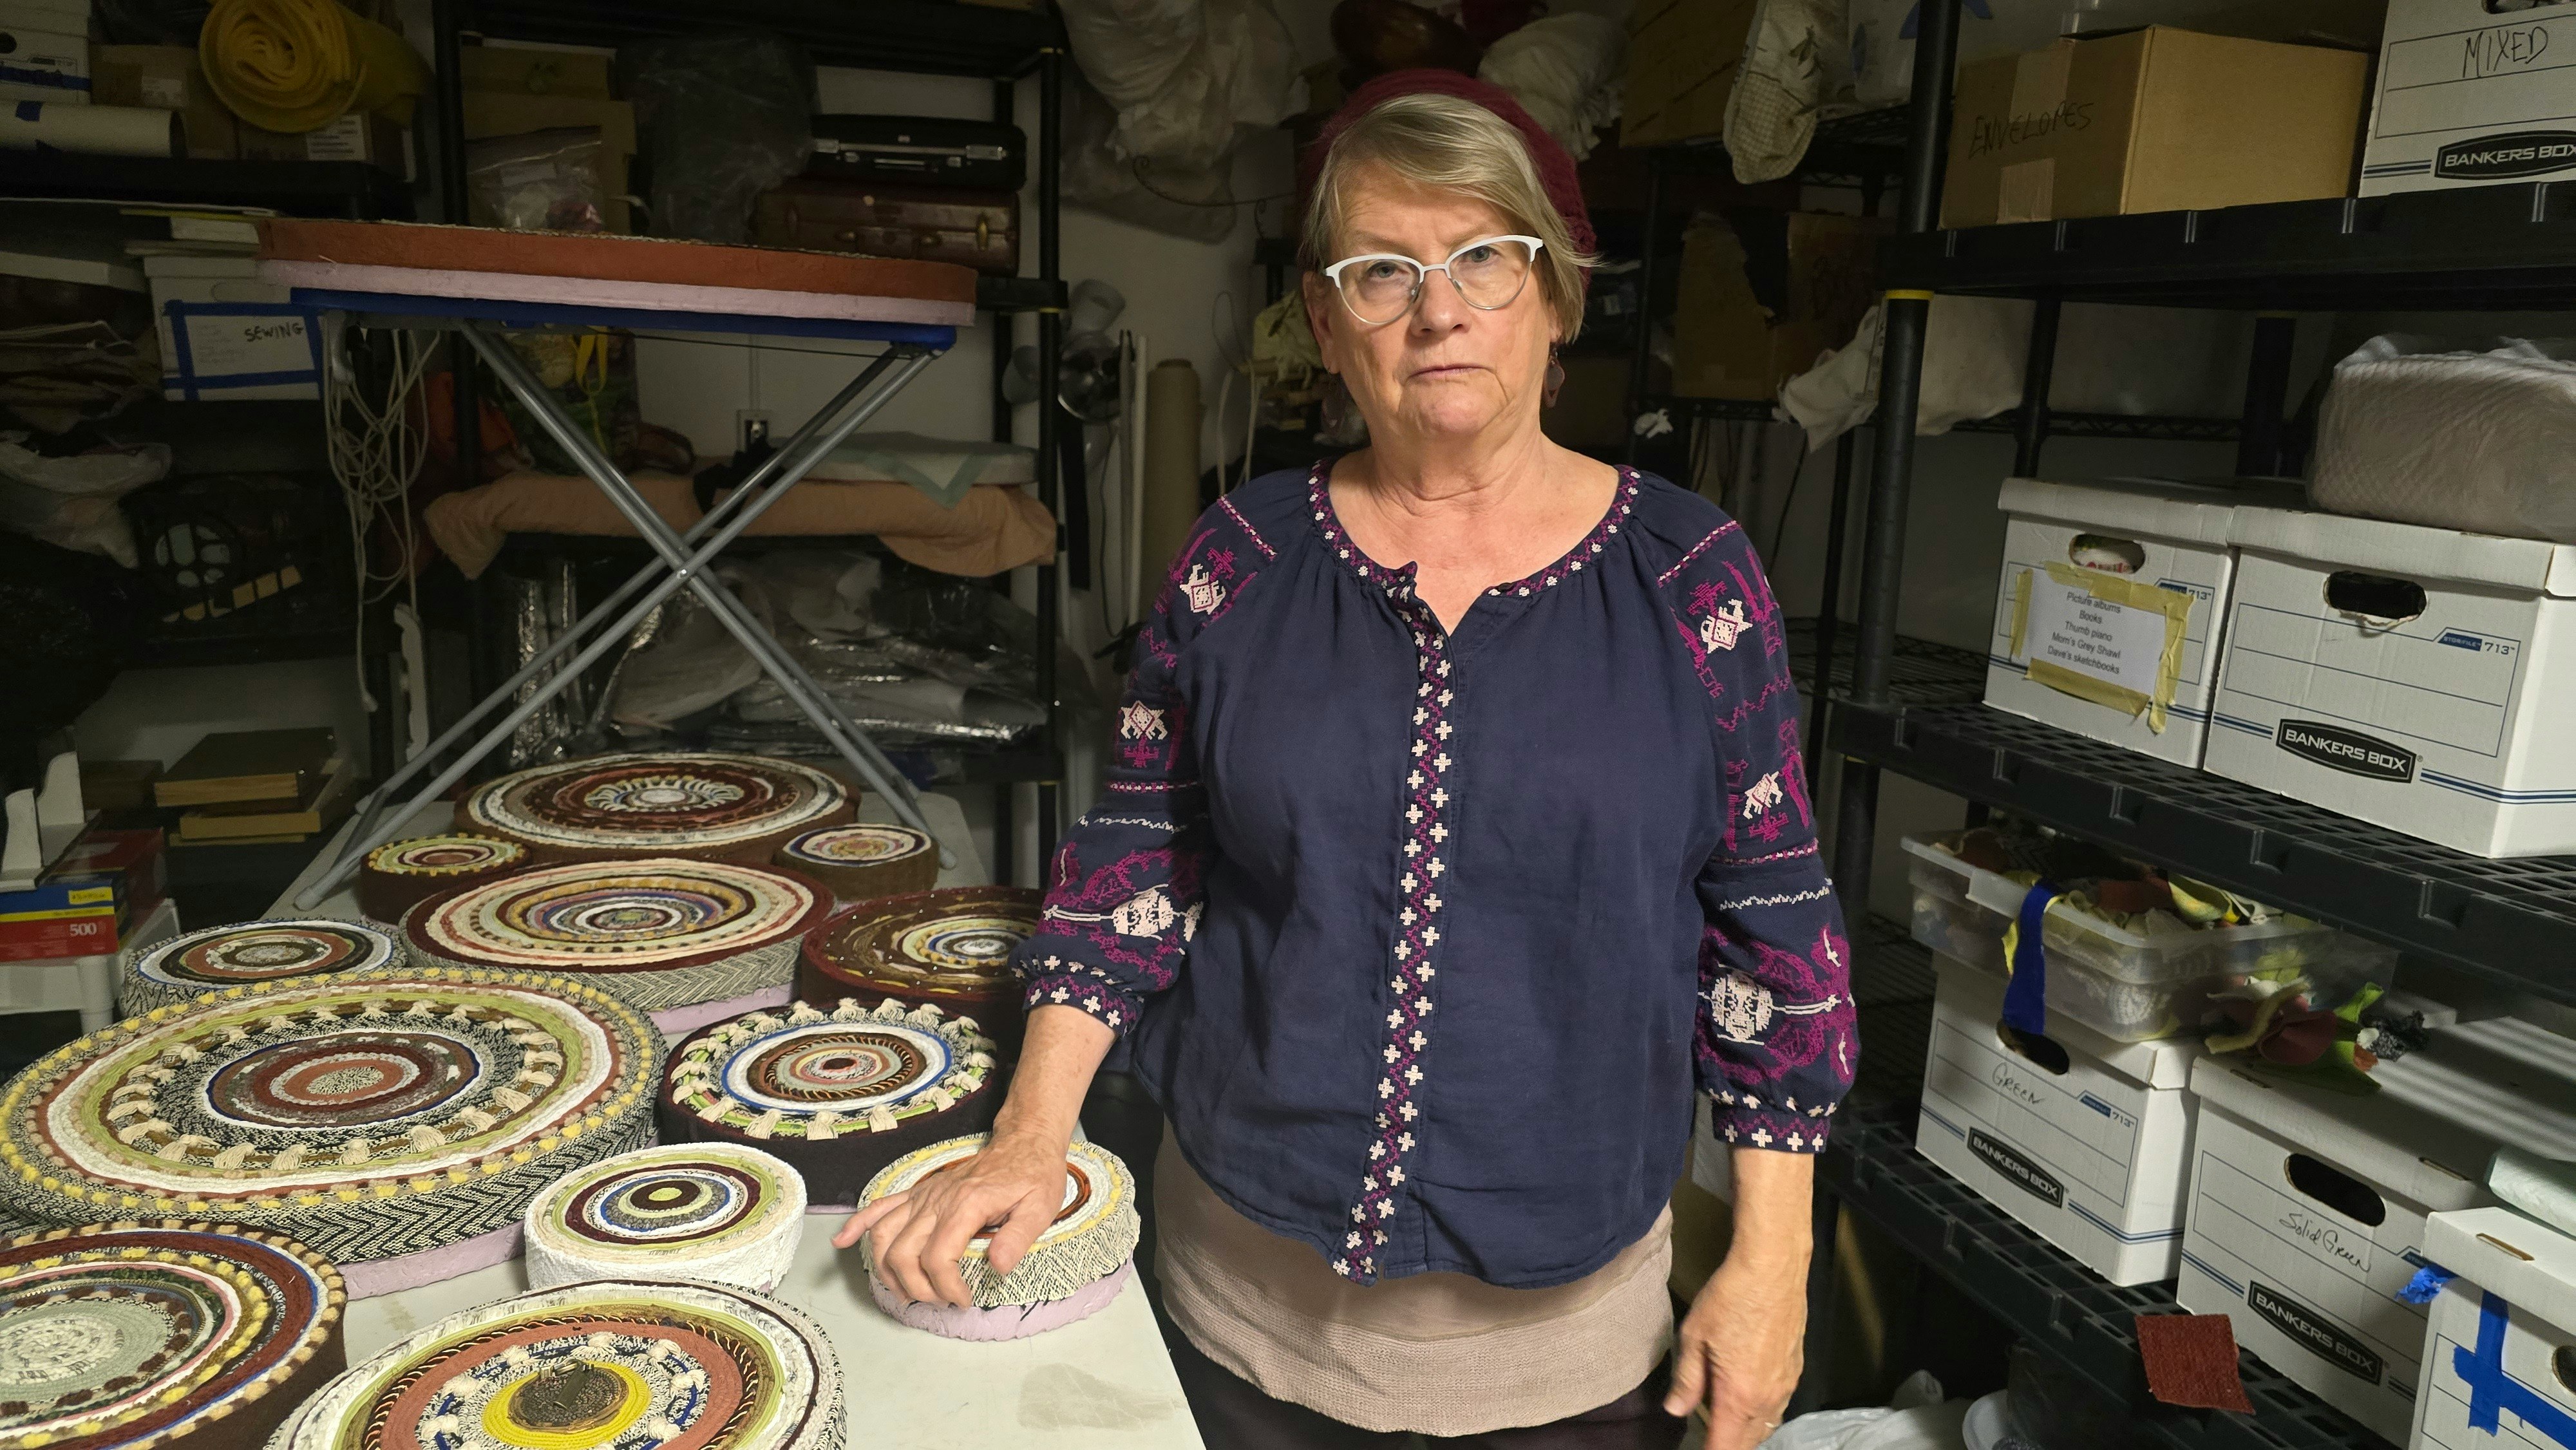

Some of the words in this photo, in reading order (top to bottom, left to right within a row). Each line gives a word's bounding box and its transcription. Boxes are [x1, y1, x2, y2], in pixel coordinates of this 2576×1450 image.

[2463, 26, 2548, 78] MIXED
[1968, 100, 2094, 160] ENVELOPES
[2445, 147, 2535, 167] BANKERS
[2538, 144, 2576, 159] BOX
[244, 321, 304, 343] SEWING
[2067, 591, 2092, 606] Picture
[2094, 599, 2121, 614] albums
[2079, 610, 2102, 624] Books
[2052, 631, 2076, 646] Mom's
[2078, 639, 2096, 654] Grey
[2098, 645, 2121, 659] Shawl
[2065, 621, 2090, 636] Thumb
[2091, 628, 2113, 642] piano
[2047, 645, 2072, 660] Dave's
[2074, 653, 2119, 675] sketchbooks
[2285, 728, 2365, 760] BANKERS
[2367, 751, 2407, 773] BOX
[70, 922, 97, 937] 500
[1973, 1135, 2029, 1181] BANKERS
[2030, 1172, 2058, 1200] BOX
[2279, 1212, 2322, 1245] Solid
[2256, 1292, 2333, 1348] BANKERS
[2336, 1343, 2374, 1373] BOX
